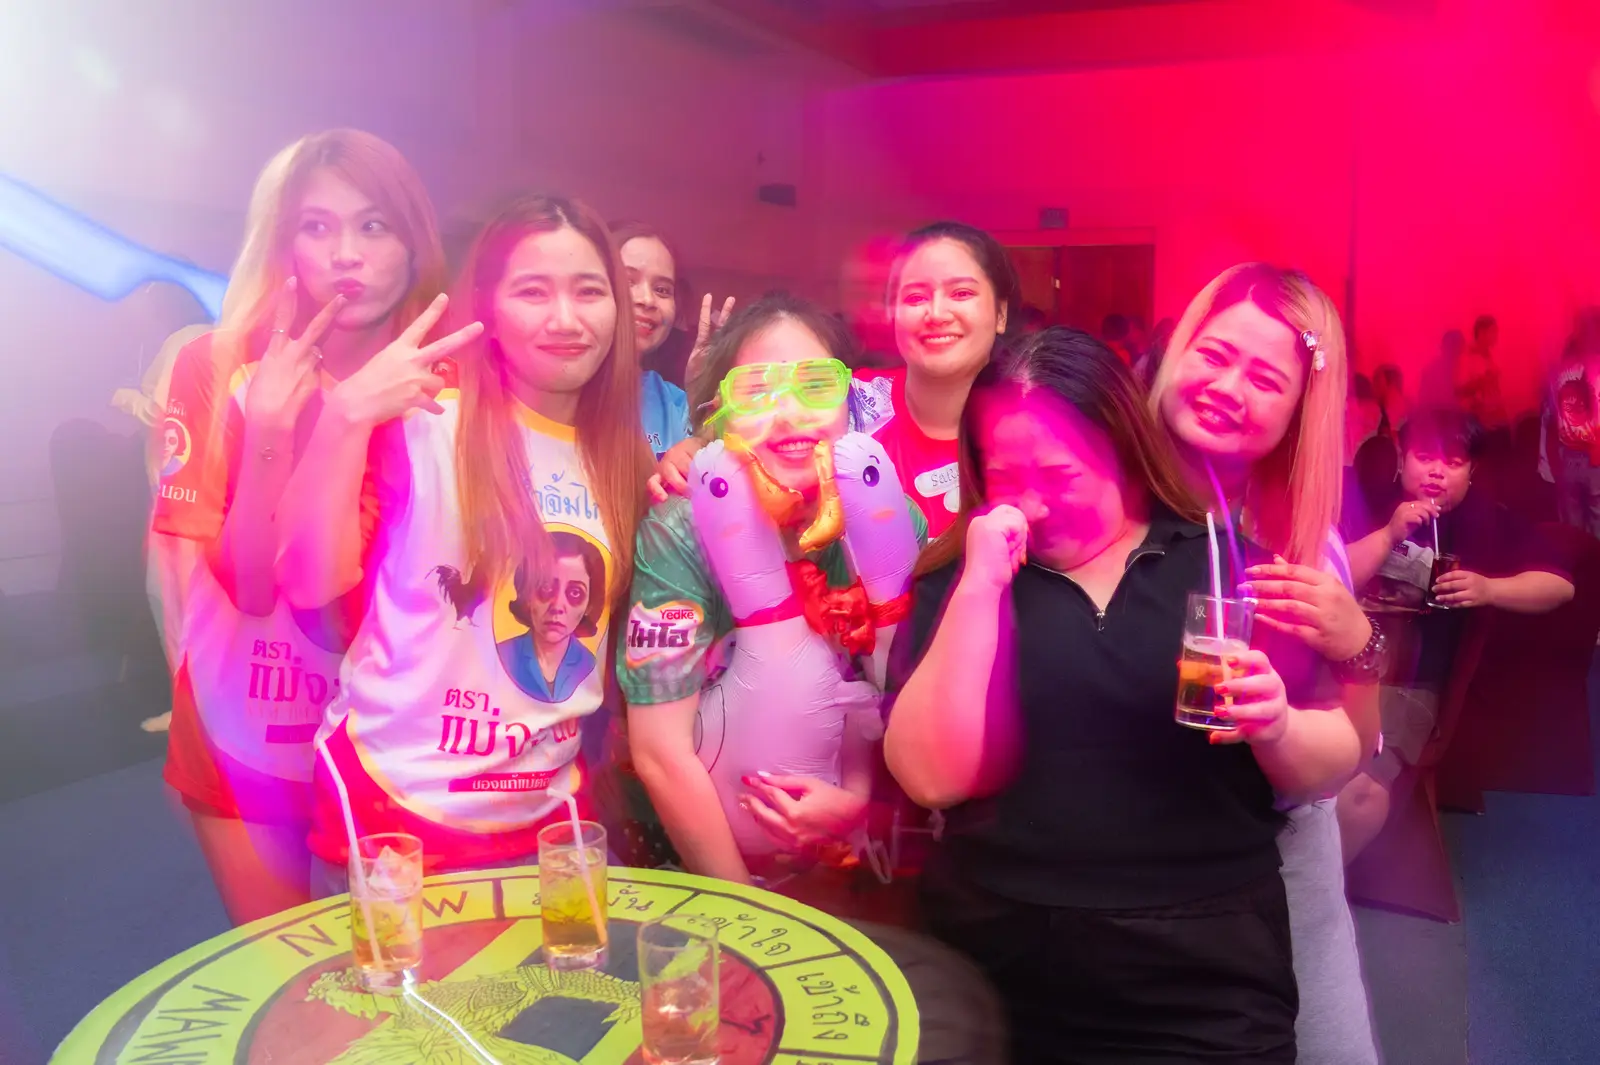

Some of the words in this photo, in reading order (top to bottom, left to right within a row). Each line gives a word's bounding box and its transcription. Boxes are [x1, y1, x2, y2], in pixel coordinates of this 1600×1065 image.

[660, 608, 694, 620] Yedke
[251, 639, 292, 660] ตรา
[443, 688, 490, 713] ตรา
